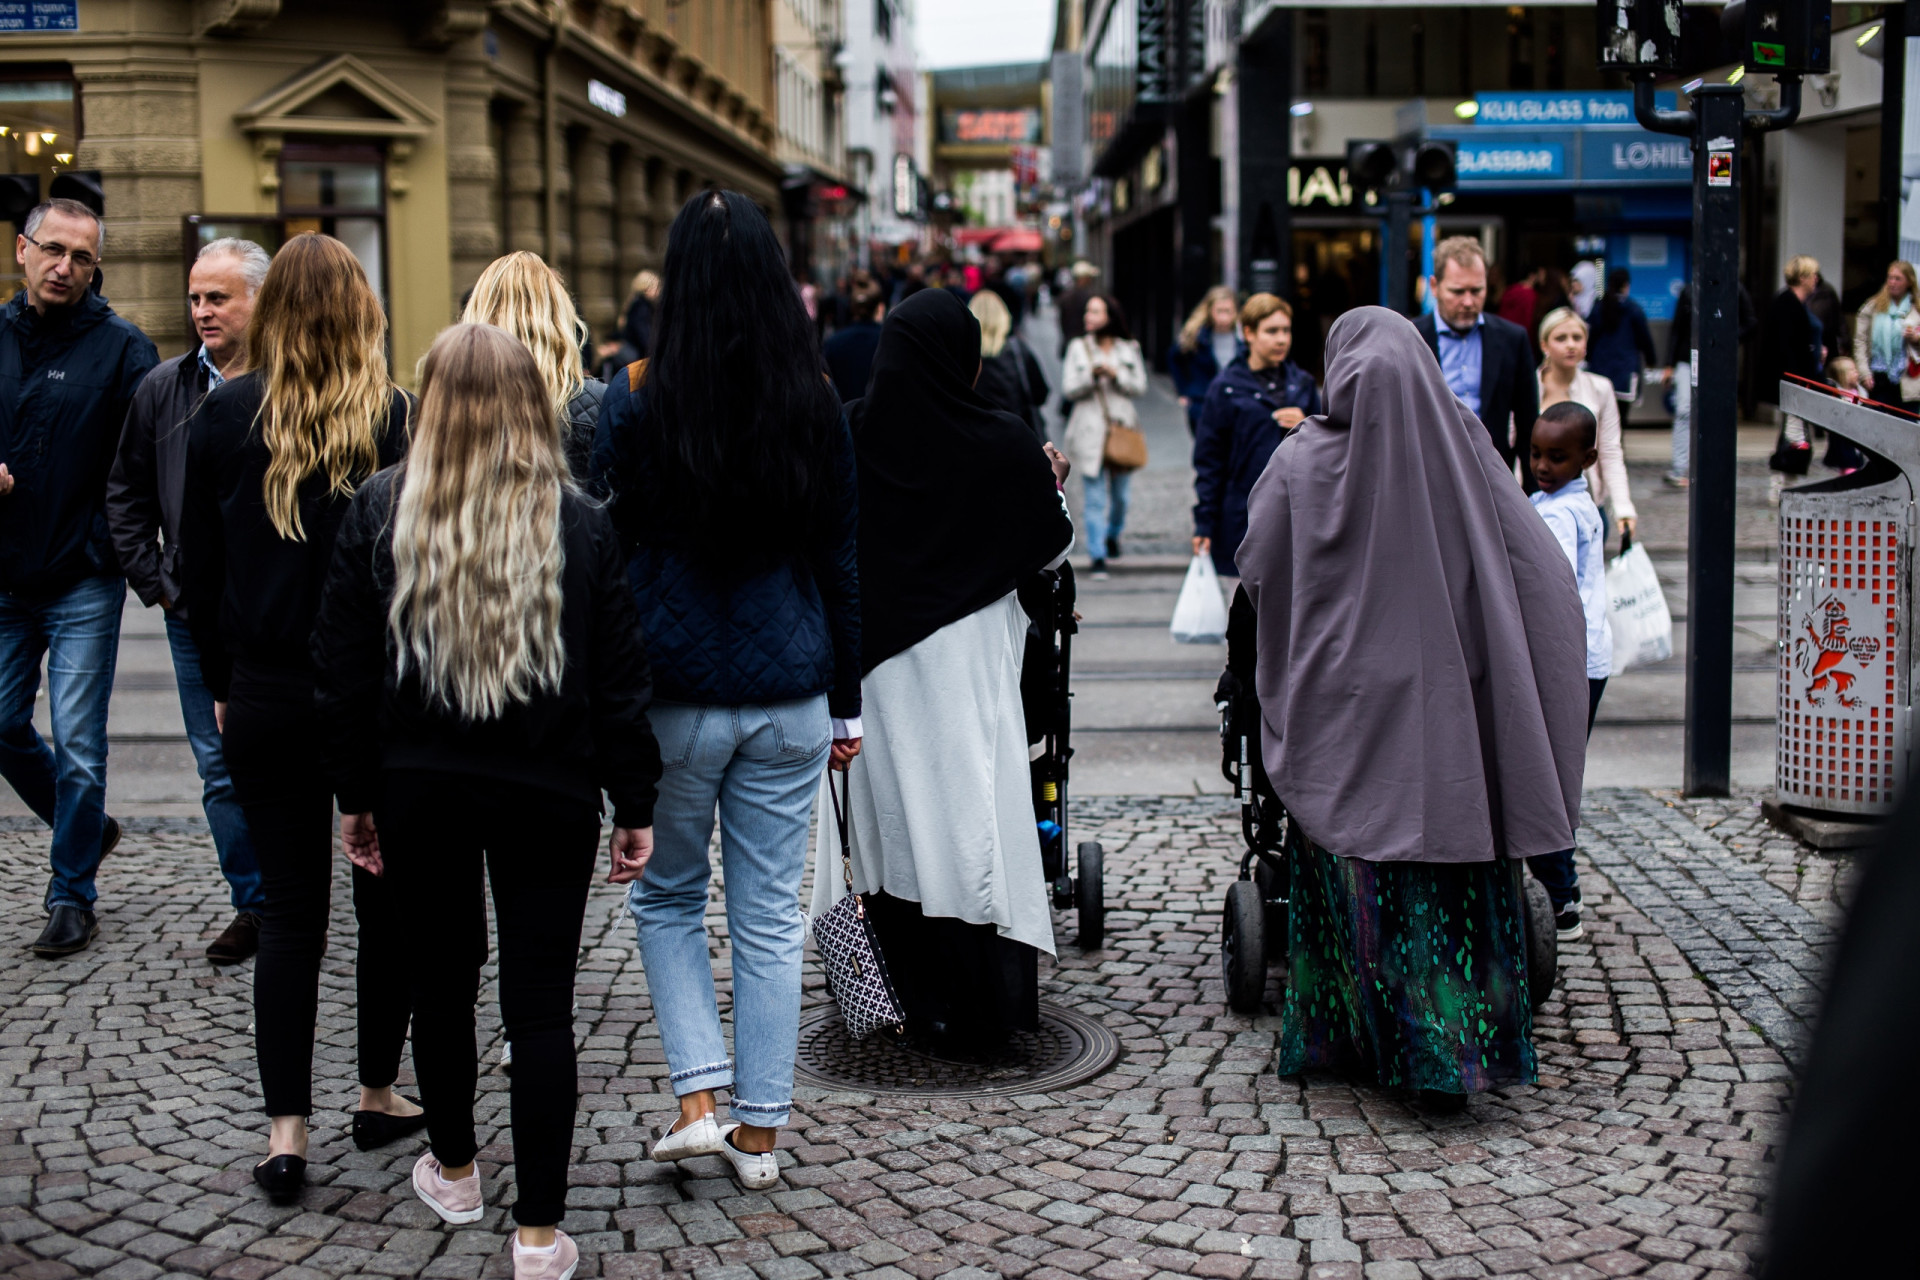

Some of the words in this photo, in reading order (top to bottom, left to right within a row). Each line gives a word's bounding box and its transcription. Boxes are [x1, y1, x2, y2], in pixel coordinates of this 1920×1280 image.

[1481, 100, 1583, 121] KULGLASS
[1588, 98, 1629, 120] från
[47, 369, 66, 380] HH
